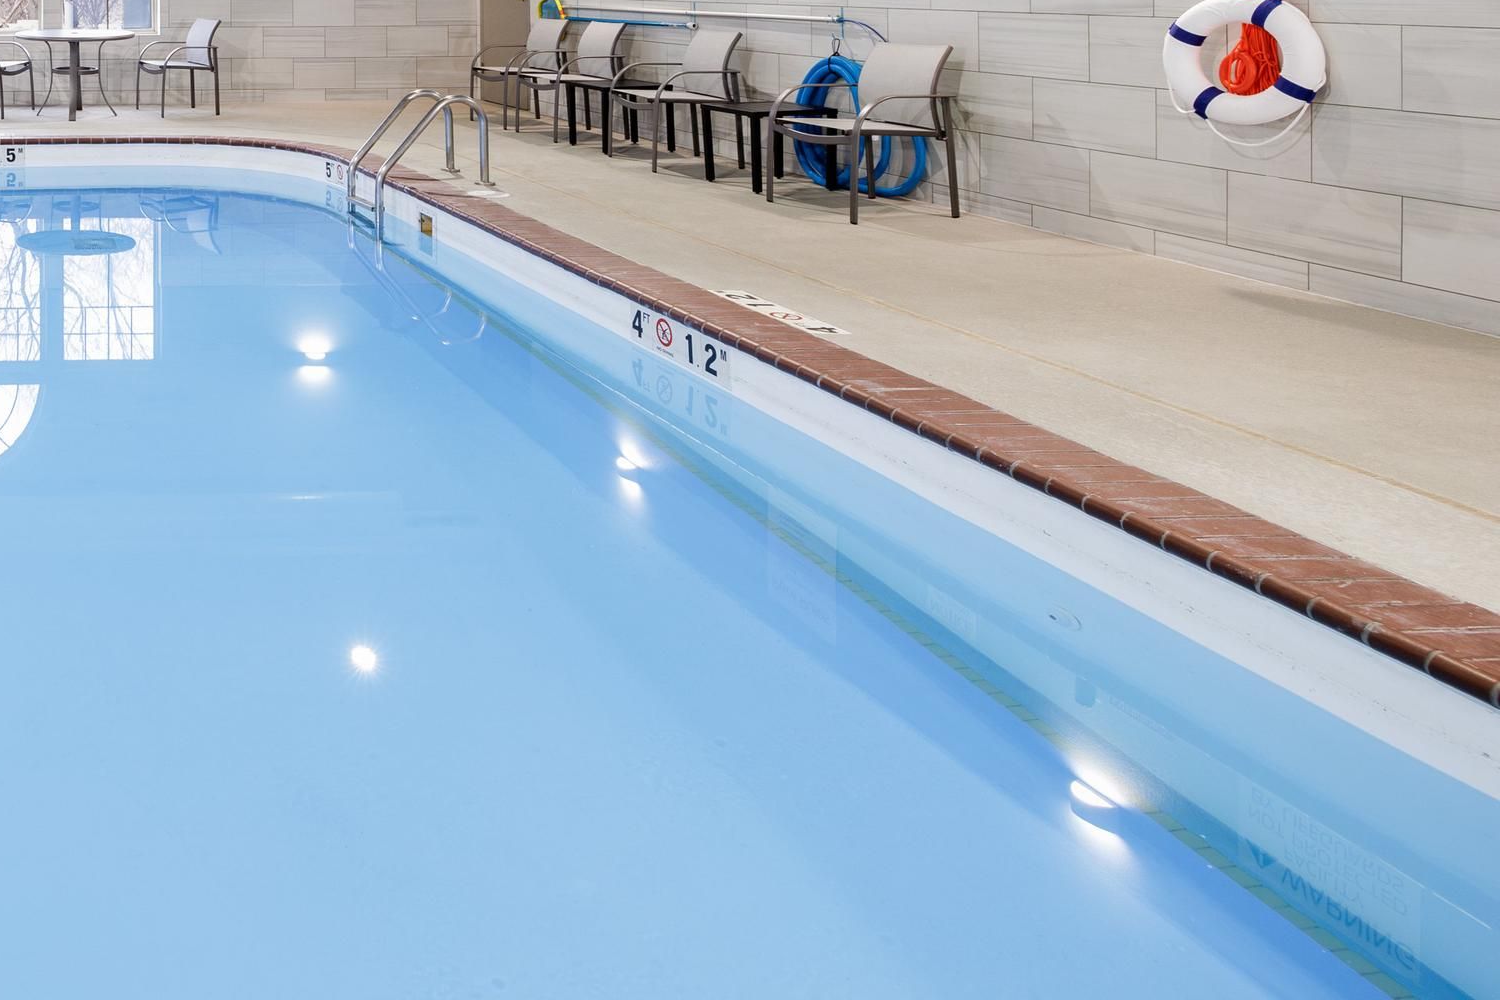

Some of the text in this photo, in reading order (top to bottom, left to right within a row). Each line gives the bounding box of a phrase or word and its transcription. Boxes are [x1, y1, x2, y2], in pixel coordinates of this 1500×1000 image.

[325, 161, 331, 178] 5
[631, 309, 643, 339] 4
[643, 312, 651, 324] FT
